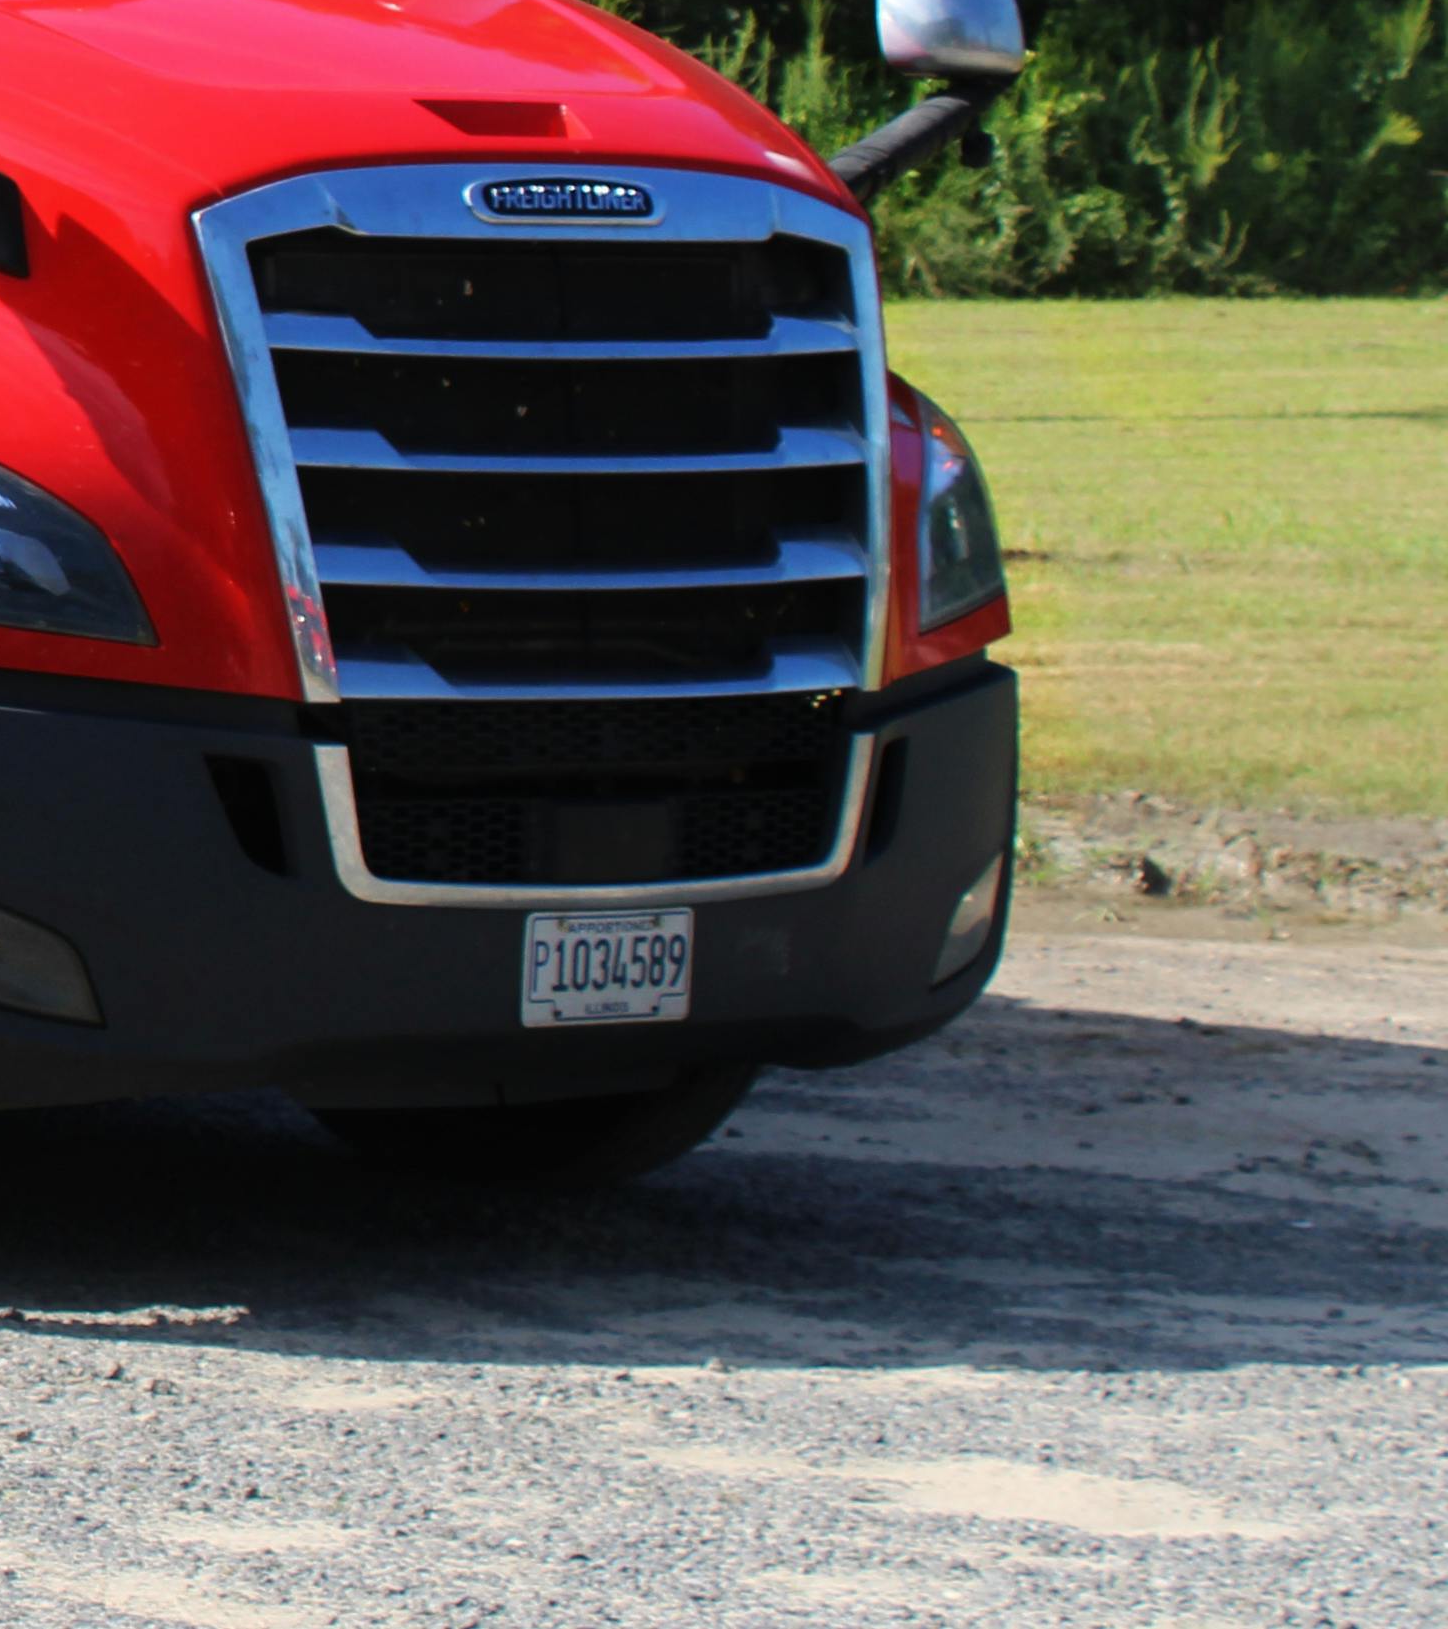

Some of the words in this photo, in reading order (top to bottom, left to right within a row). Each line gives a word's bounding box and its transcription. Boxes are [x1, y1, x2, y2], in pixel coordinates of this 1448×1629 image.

[489, 184, 648, 211] FREIGHTLINER
[532, 935, 687, 993] P1034589
[584, 1001, 630, 1015] ILLINOIS
